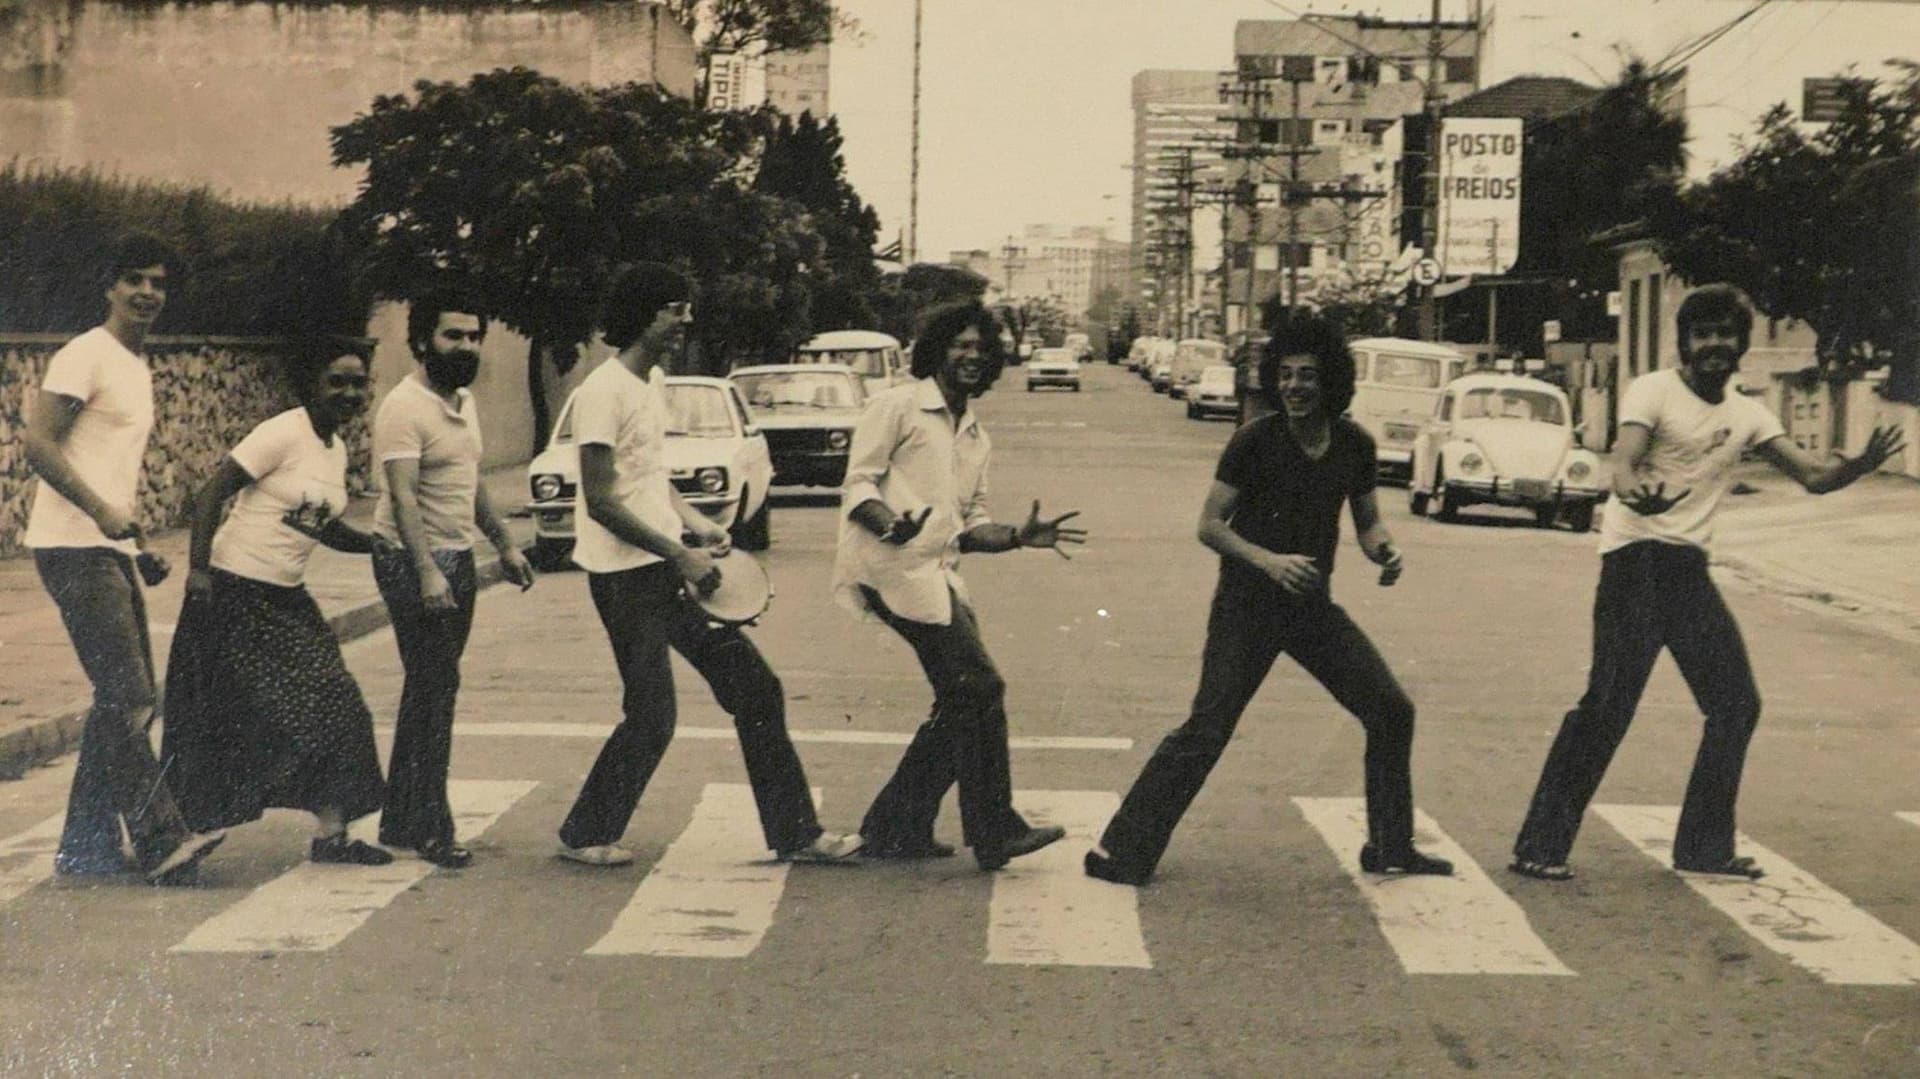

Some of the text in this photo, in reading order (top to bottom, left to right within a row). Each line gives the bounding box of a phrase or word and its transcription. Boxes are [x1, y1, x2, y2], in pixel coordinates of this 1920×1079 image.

[712, 60, 730, 110] TIPO
[1446, 133, 1516, 156] POSTO
[1443, 176, 1517, 200] FREIOS
